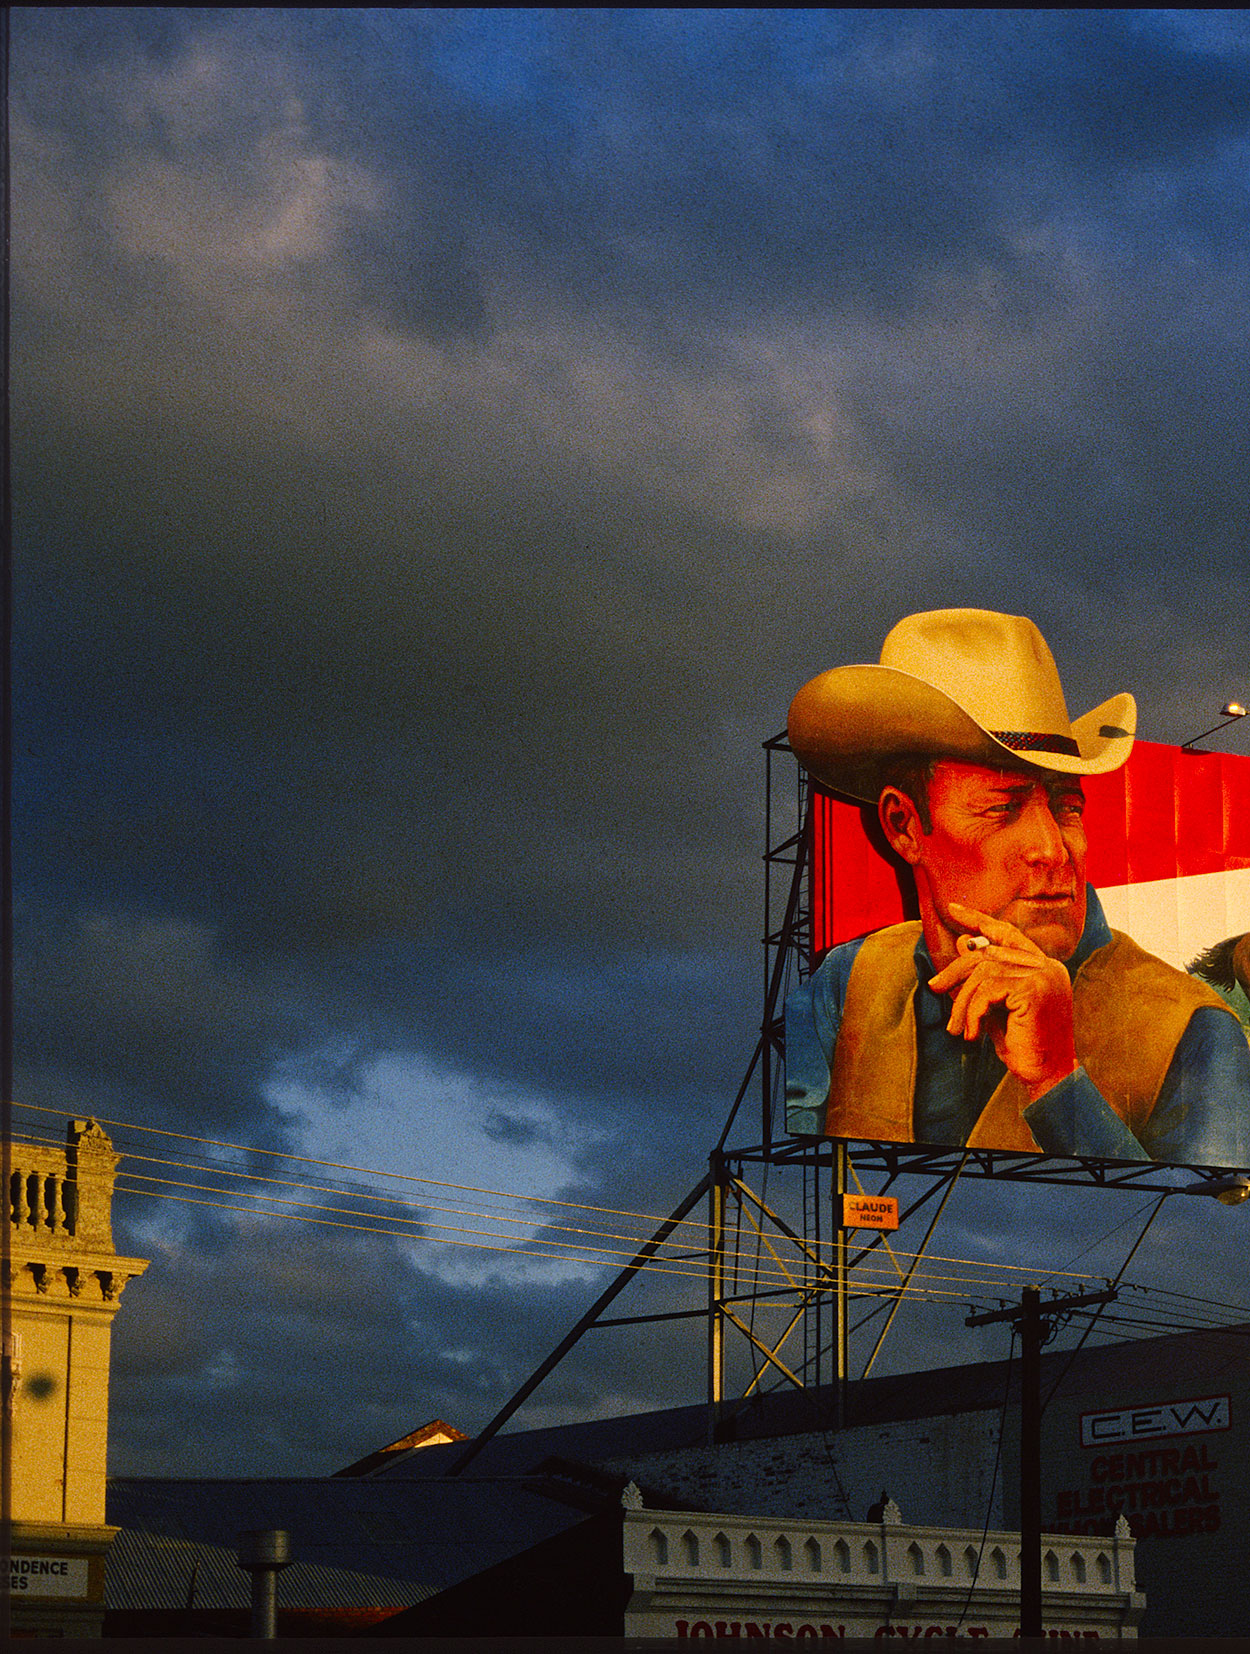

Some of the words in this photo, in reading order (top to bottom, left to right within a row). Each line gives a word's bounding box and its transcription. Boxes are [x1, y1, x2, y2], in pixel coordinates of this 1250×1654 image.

[848, 1201, 893, 1214] CLAUDE
[860, 1213, 883, 1223] NEON
[1092, 1402, 1222, 1439] C.E.W.
[1091, 1444, 1219, 1483] CENTRAL
[1057, 1475, 1220, 1518] ELECTRICAL
